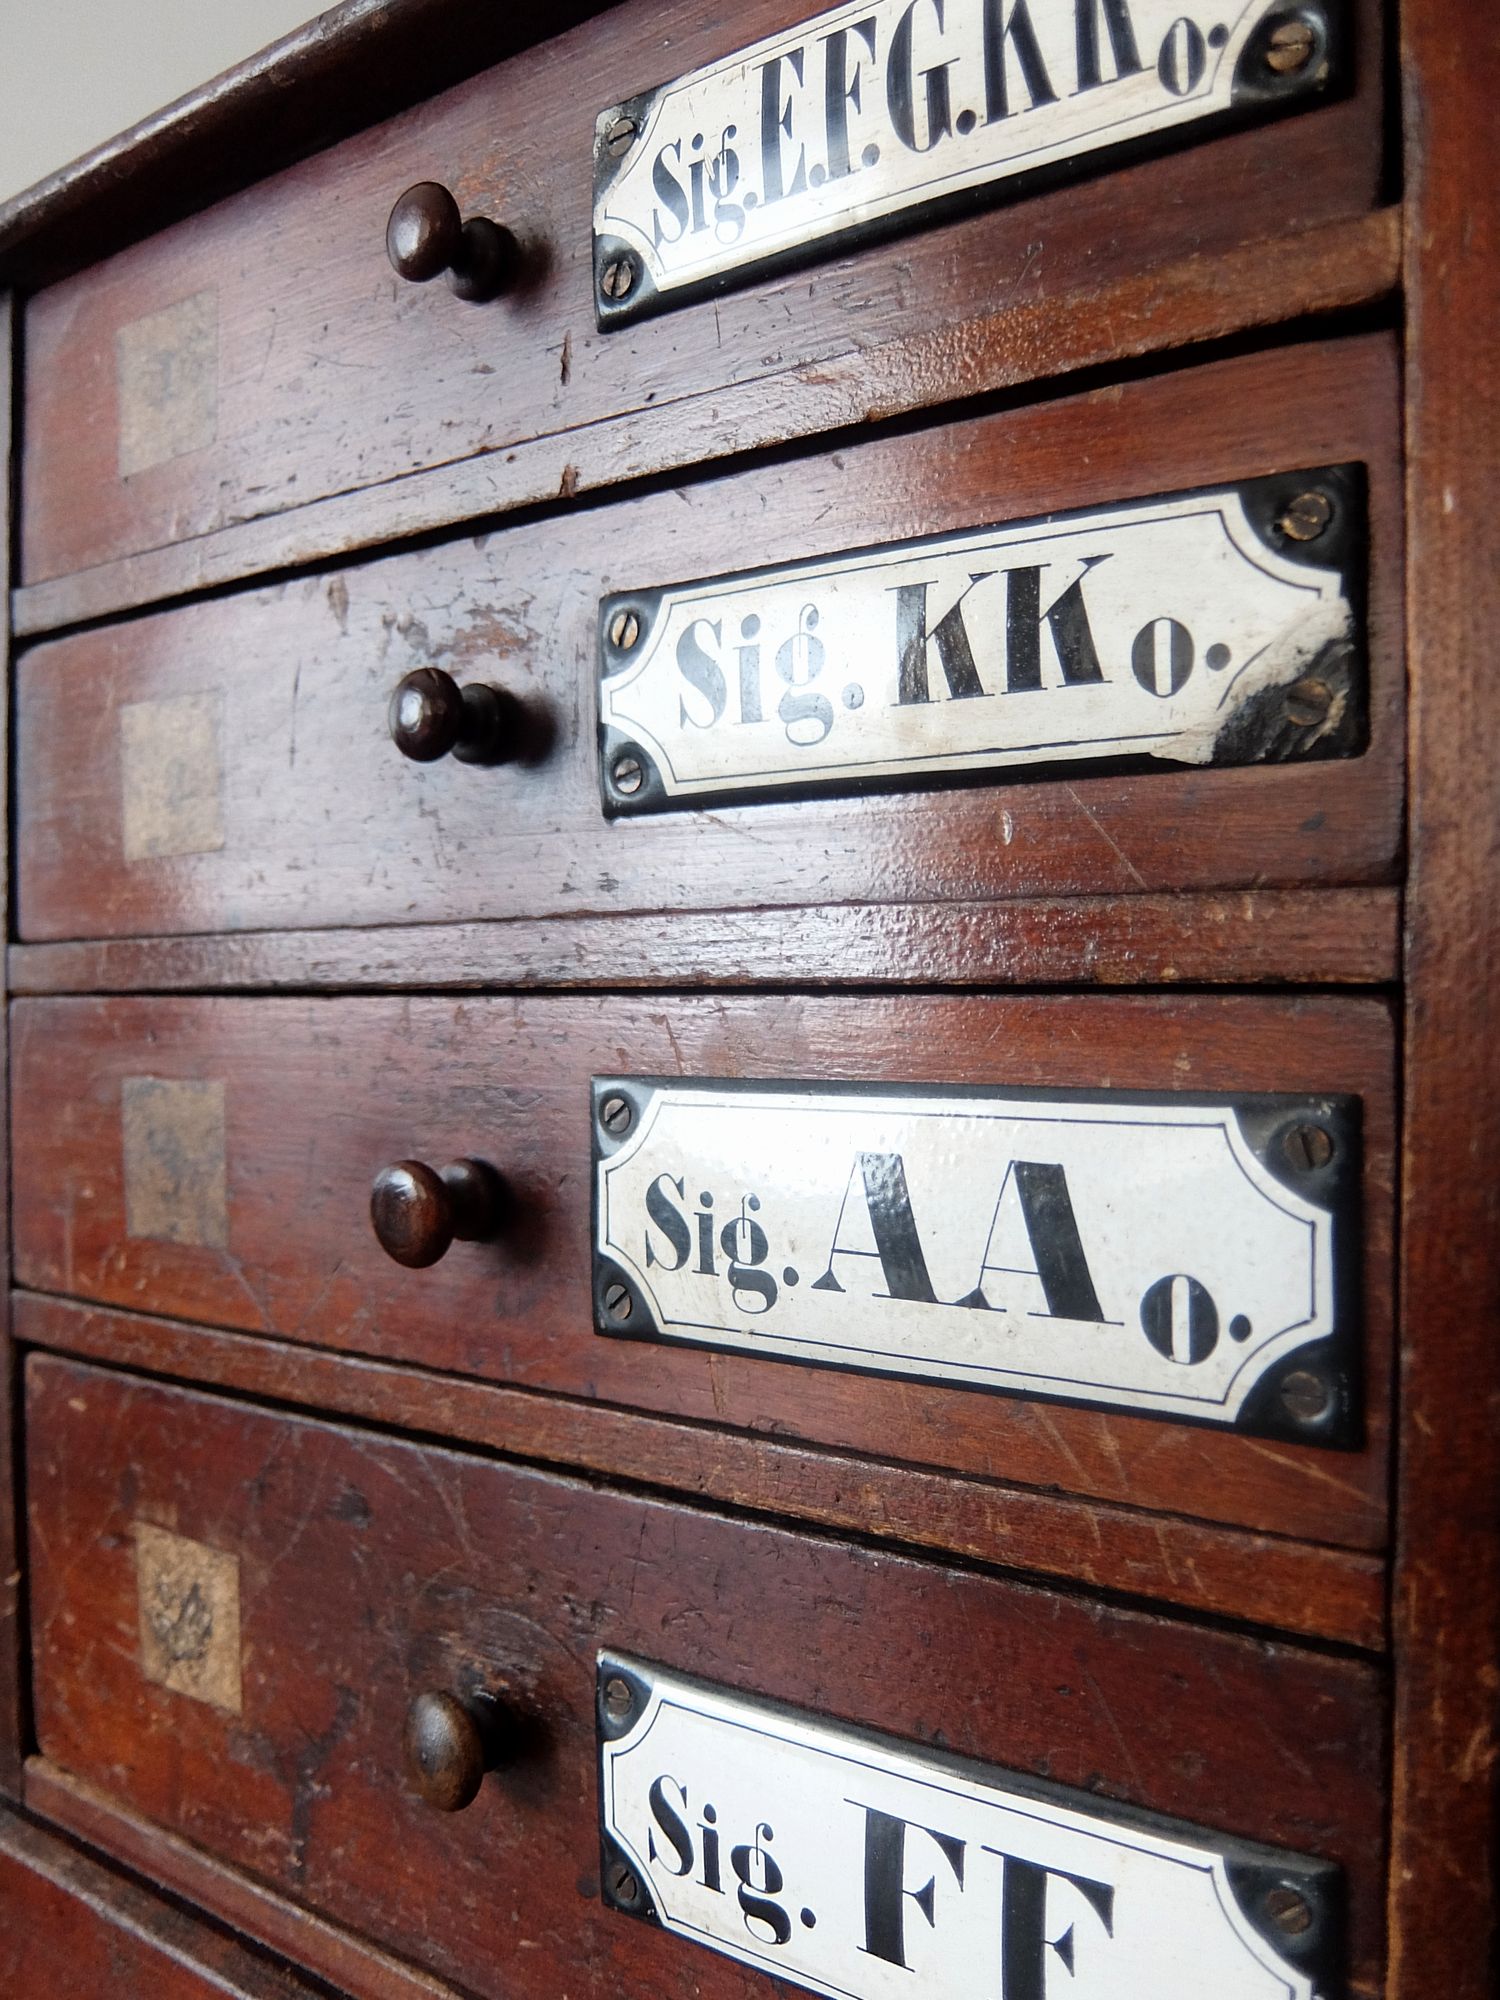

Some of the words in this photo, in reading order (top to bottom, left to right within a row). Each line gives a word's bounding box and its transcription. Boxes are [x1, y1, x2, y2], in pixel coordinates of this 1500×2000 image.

[675, 603, 865, 746] Sig.
[645, 1172, 800, 1313] Sig.
[648, 1774, 816, 1945] Sig.
[843, 1797, 1115, 2000] FF
